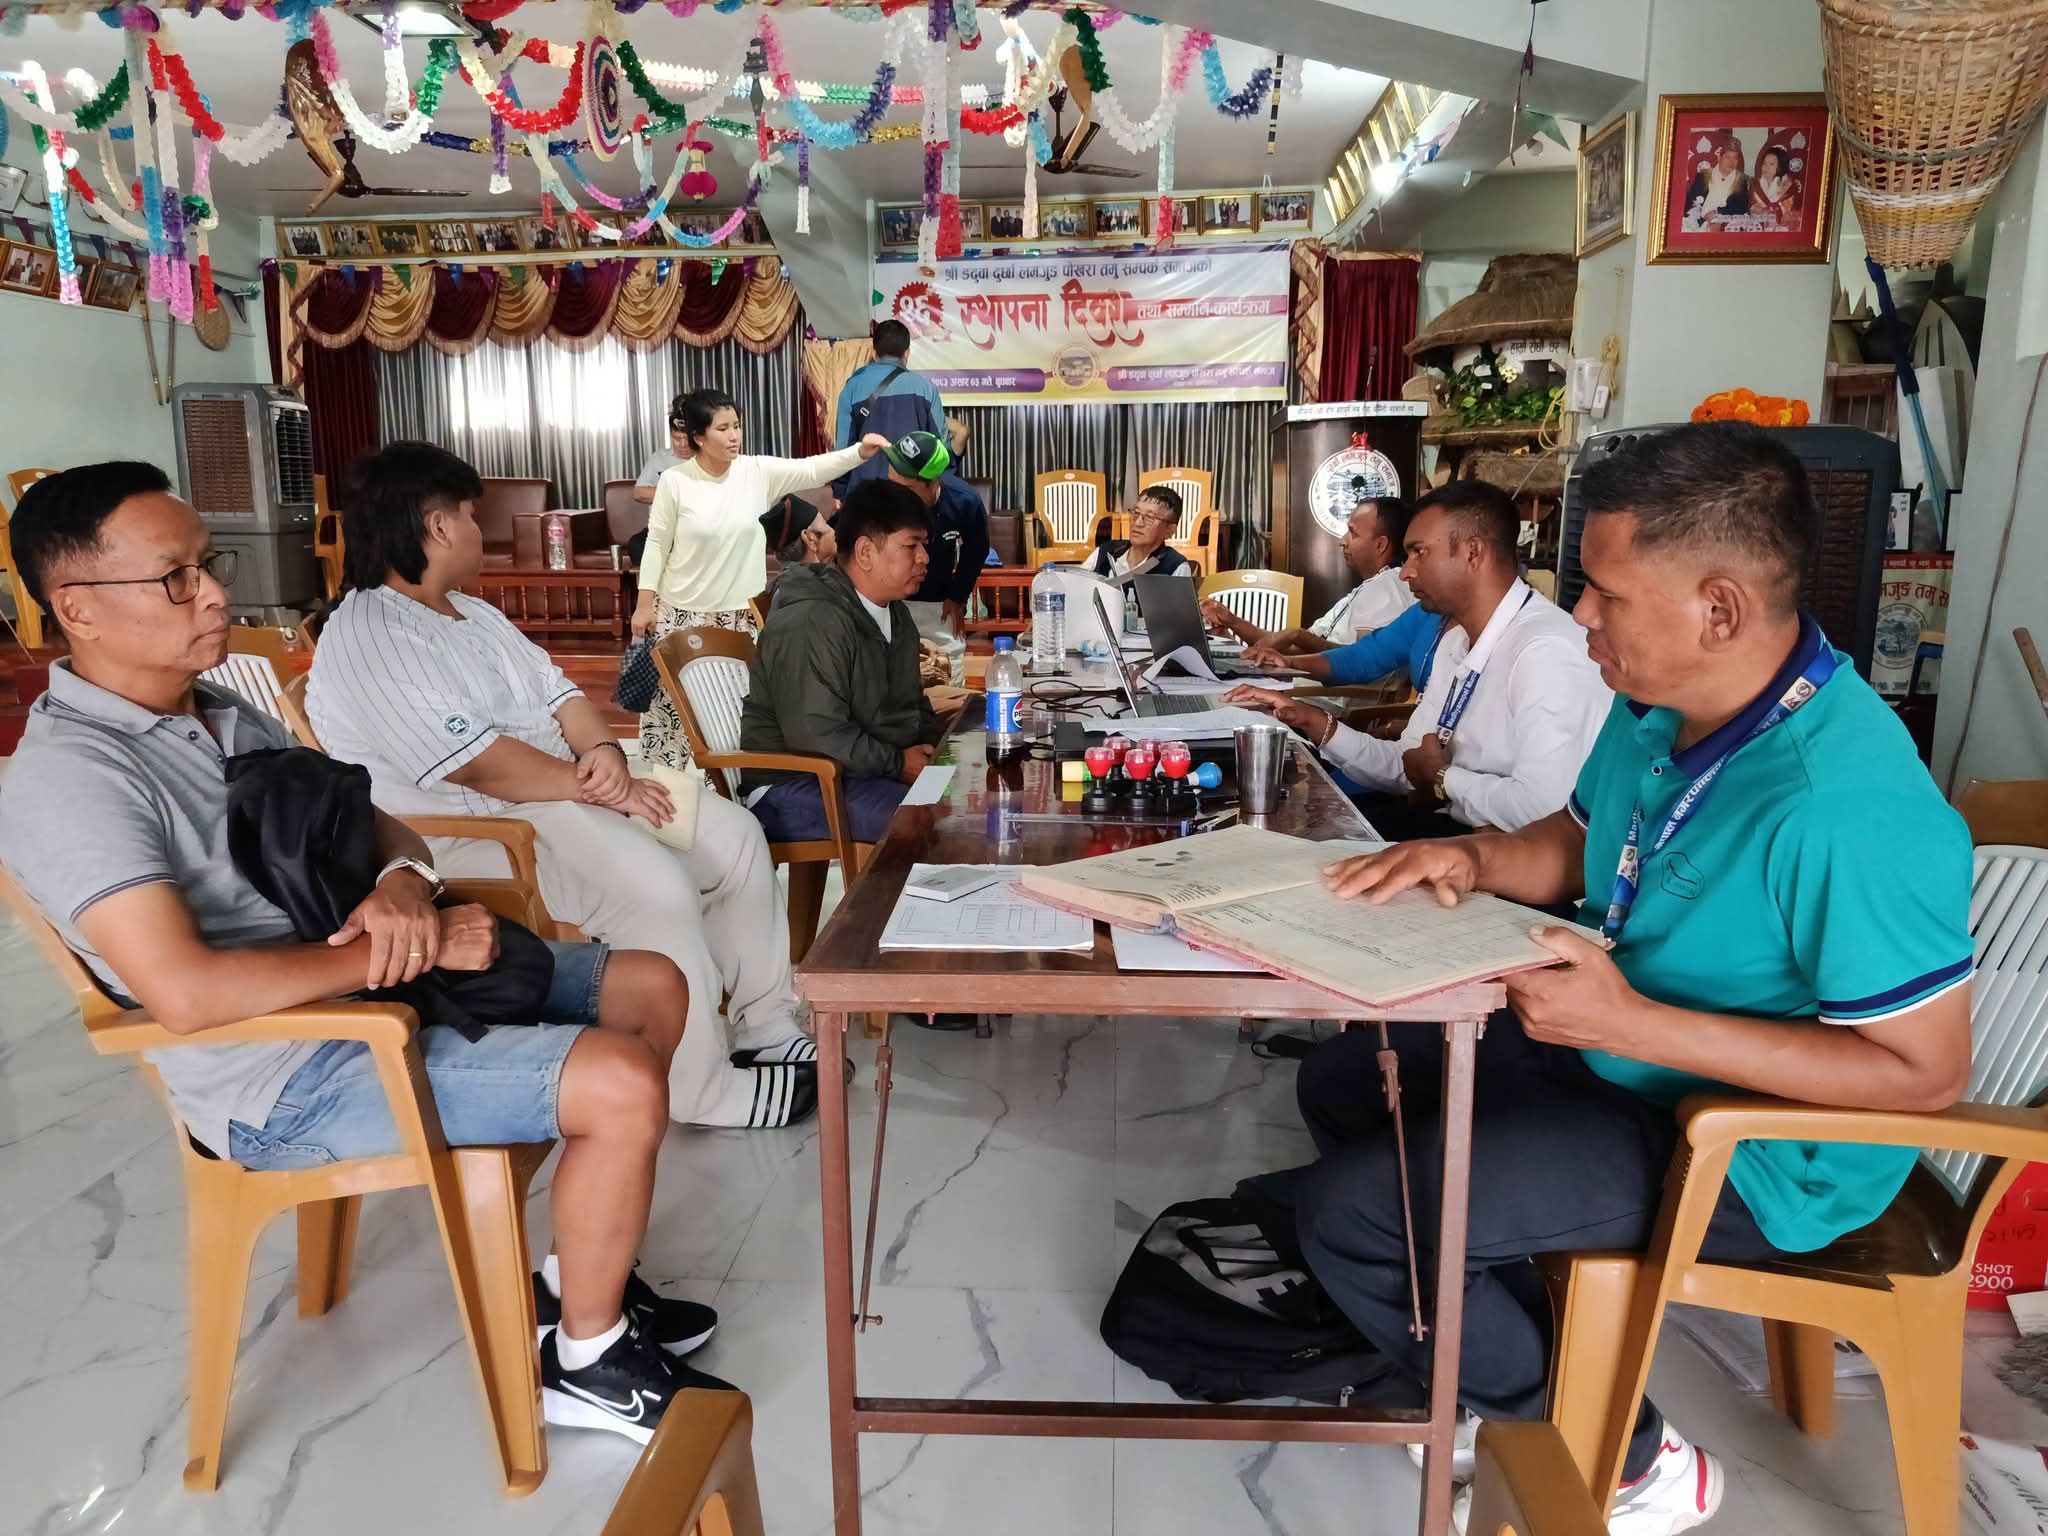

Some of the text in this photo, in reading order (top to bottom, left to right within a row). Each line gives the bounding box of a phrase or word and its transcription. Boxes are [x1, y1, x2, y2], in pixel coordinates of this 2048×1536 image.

[945, 265, 958, 281] श्री
[1063, 261, 1096, 278] पोखरा
[1100, 262, 1118, 279] तमु
[956, 294, 1051, 350] स्थापना
[1137, 304, 1162, 320] तथा
[1915, 583, 1937, 607] तमु
[1975, 1263, 2014, 1275] SHOT
